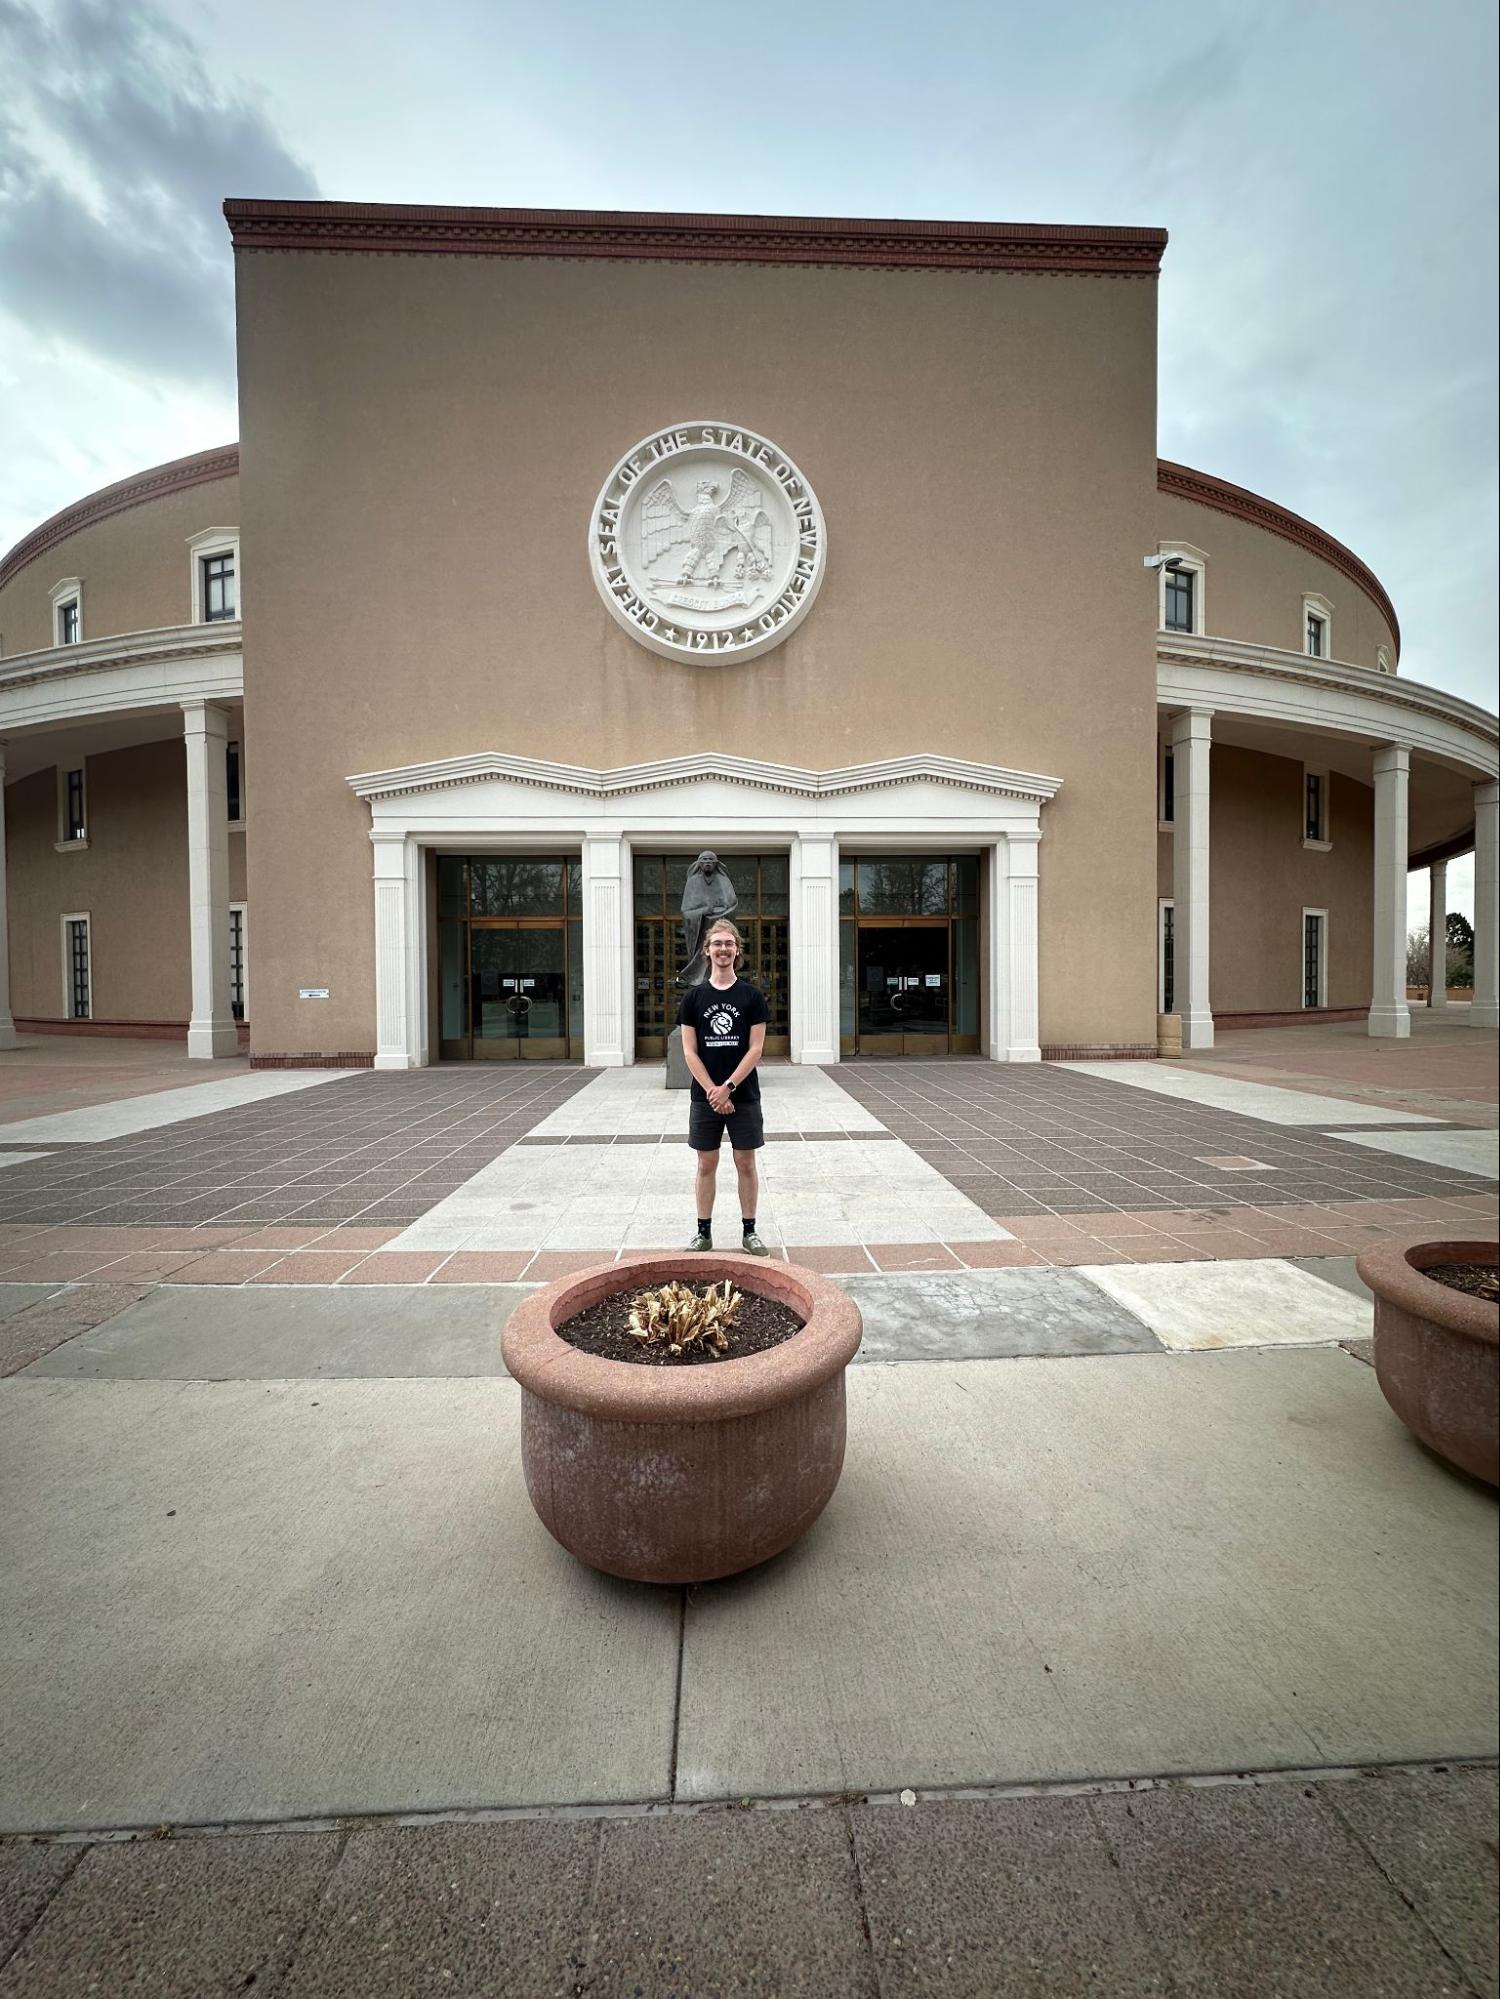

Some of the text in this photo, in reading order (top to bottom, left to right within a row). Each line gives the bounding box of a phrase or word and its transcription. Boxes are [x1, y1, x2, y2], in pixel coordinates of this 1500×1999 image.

[599, 428, 817, 631] GREAT SEAL OF THE STATE OF NEW MEXICO
[687, 631, 736, 648] 1912
[703, 1003, 740, 1018] NEW YORK
